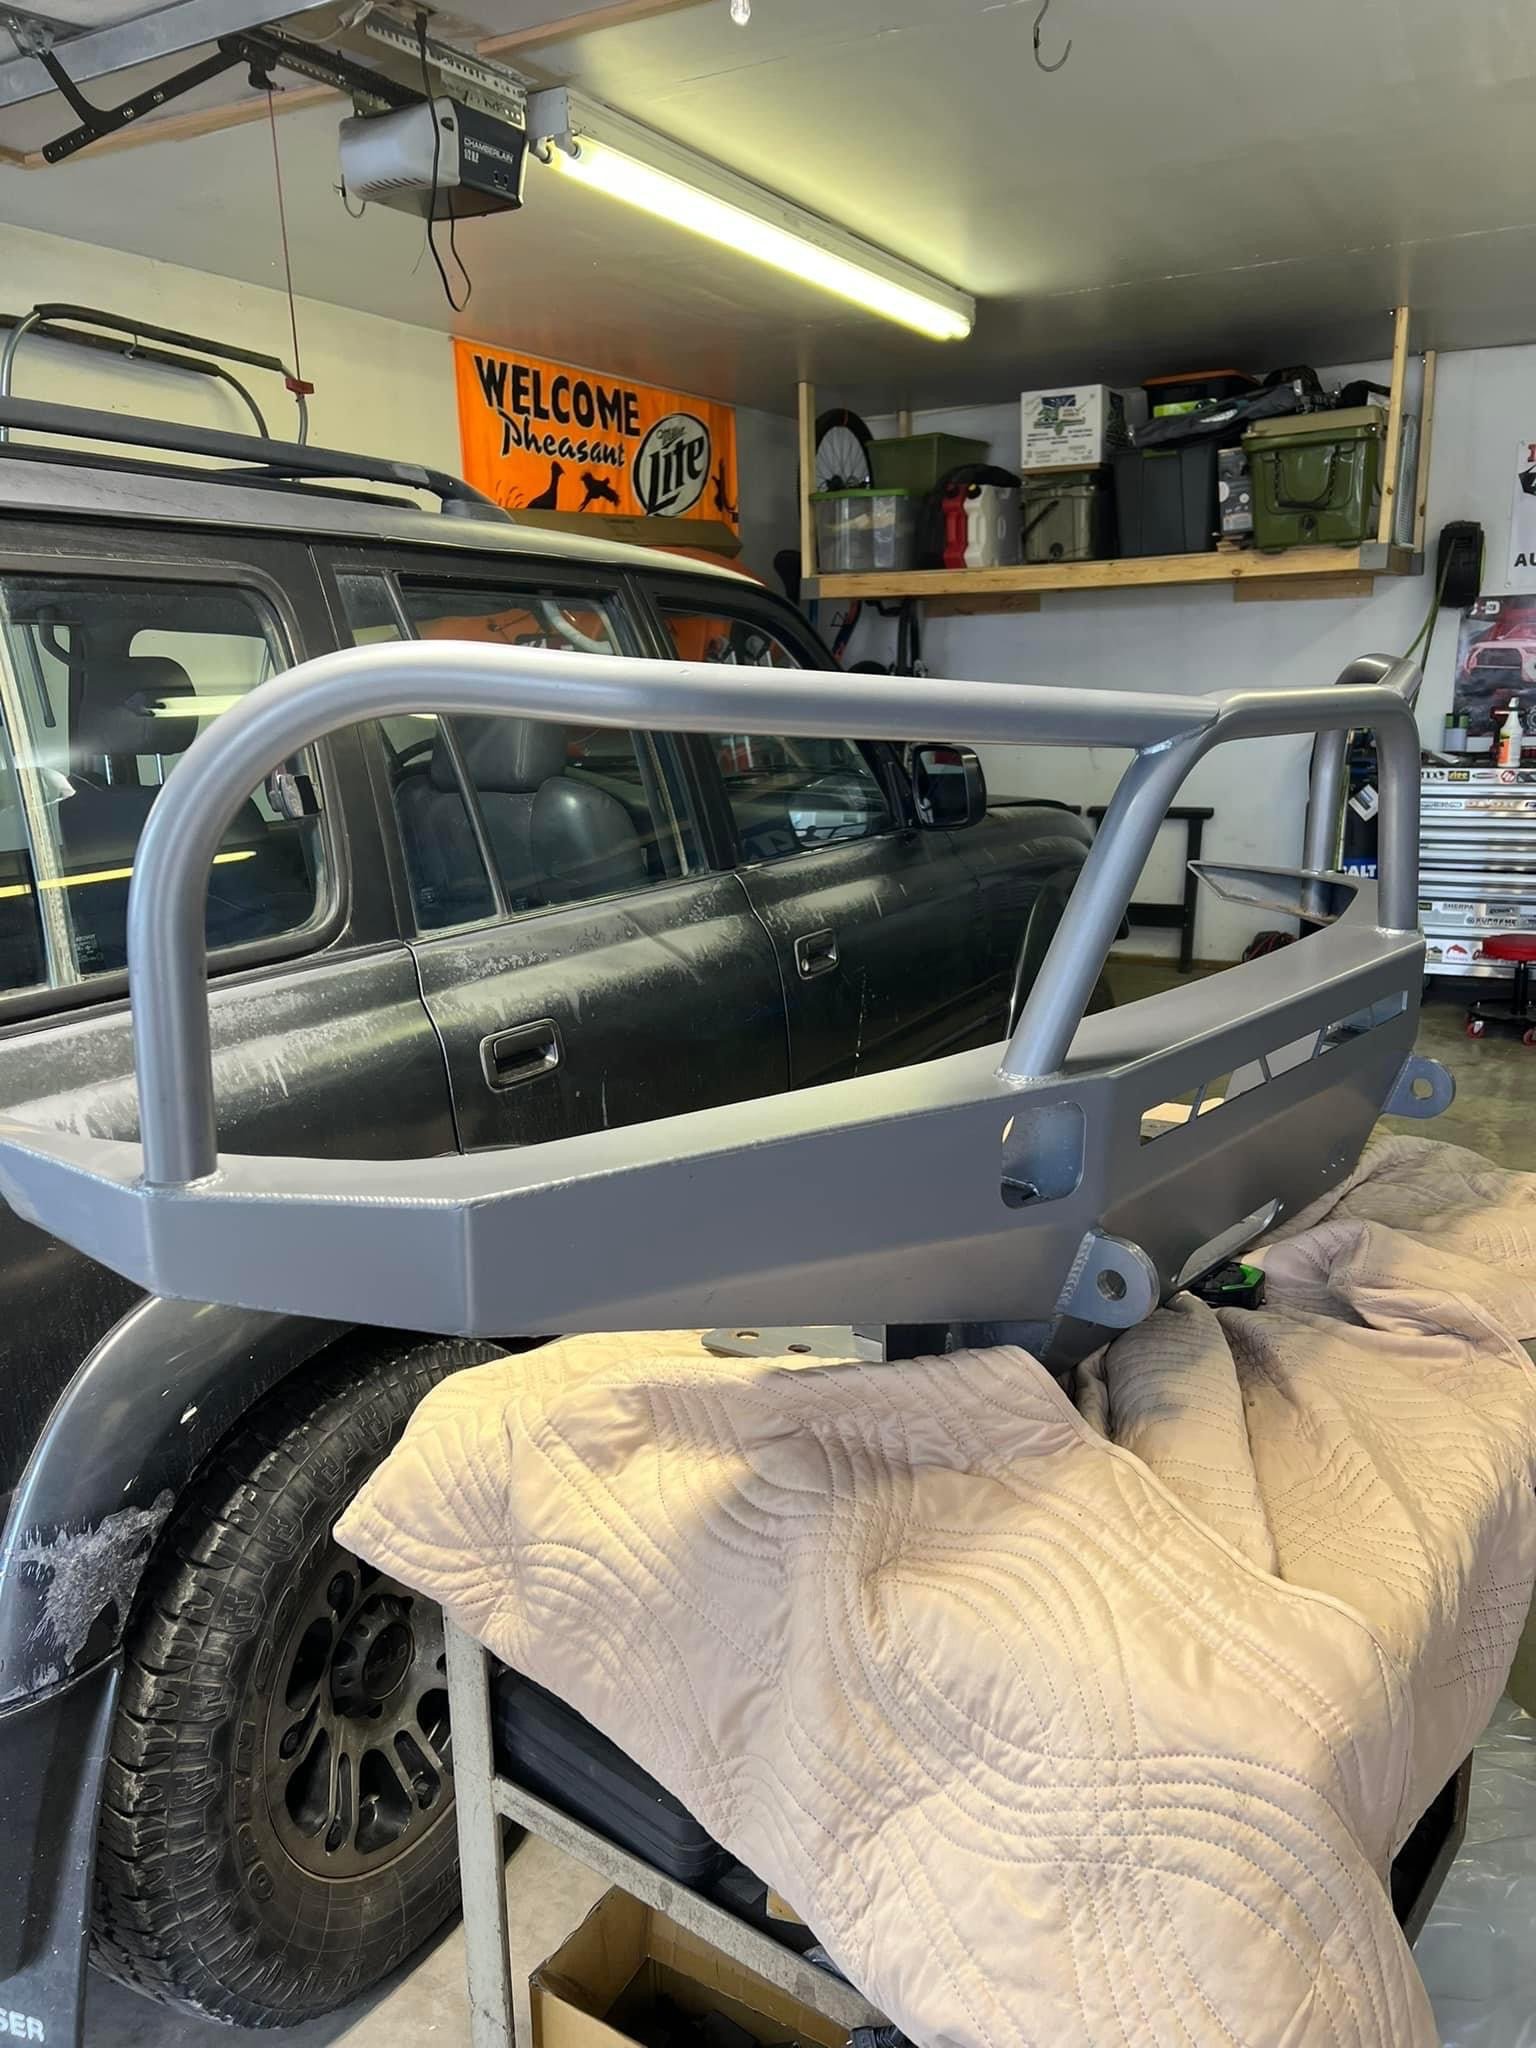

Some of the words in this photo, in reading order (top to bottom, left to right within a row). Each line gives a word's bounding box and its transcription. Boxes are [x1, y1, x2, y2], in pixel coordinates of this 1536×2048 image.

[463, 137, 514, 164] CHAMBERLAIN
[474, 355, 641, 437] WELCOME
[499, 407, 625, 468] Pheasant
[647, 436, 704, 515] Lite
